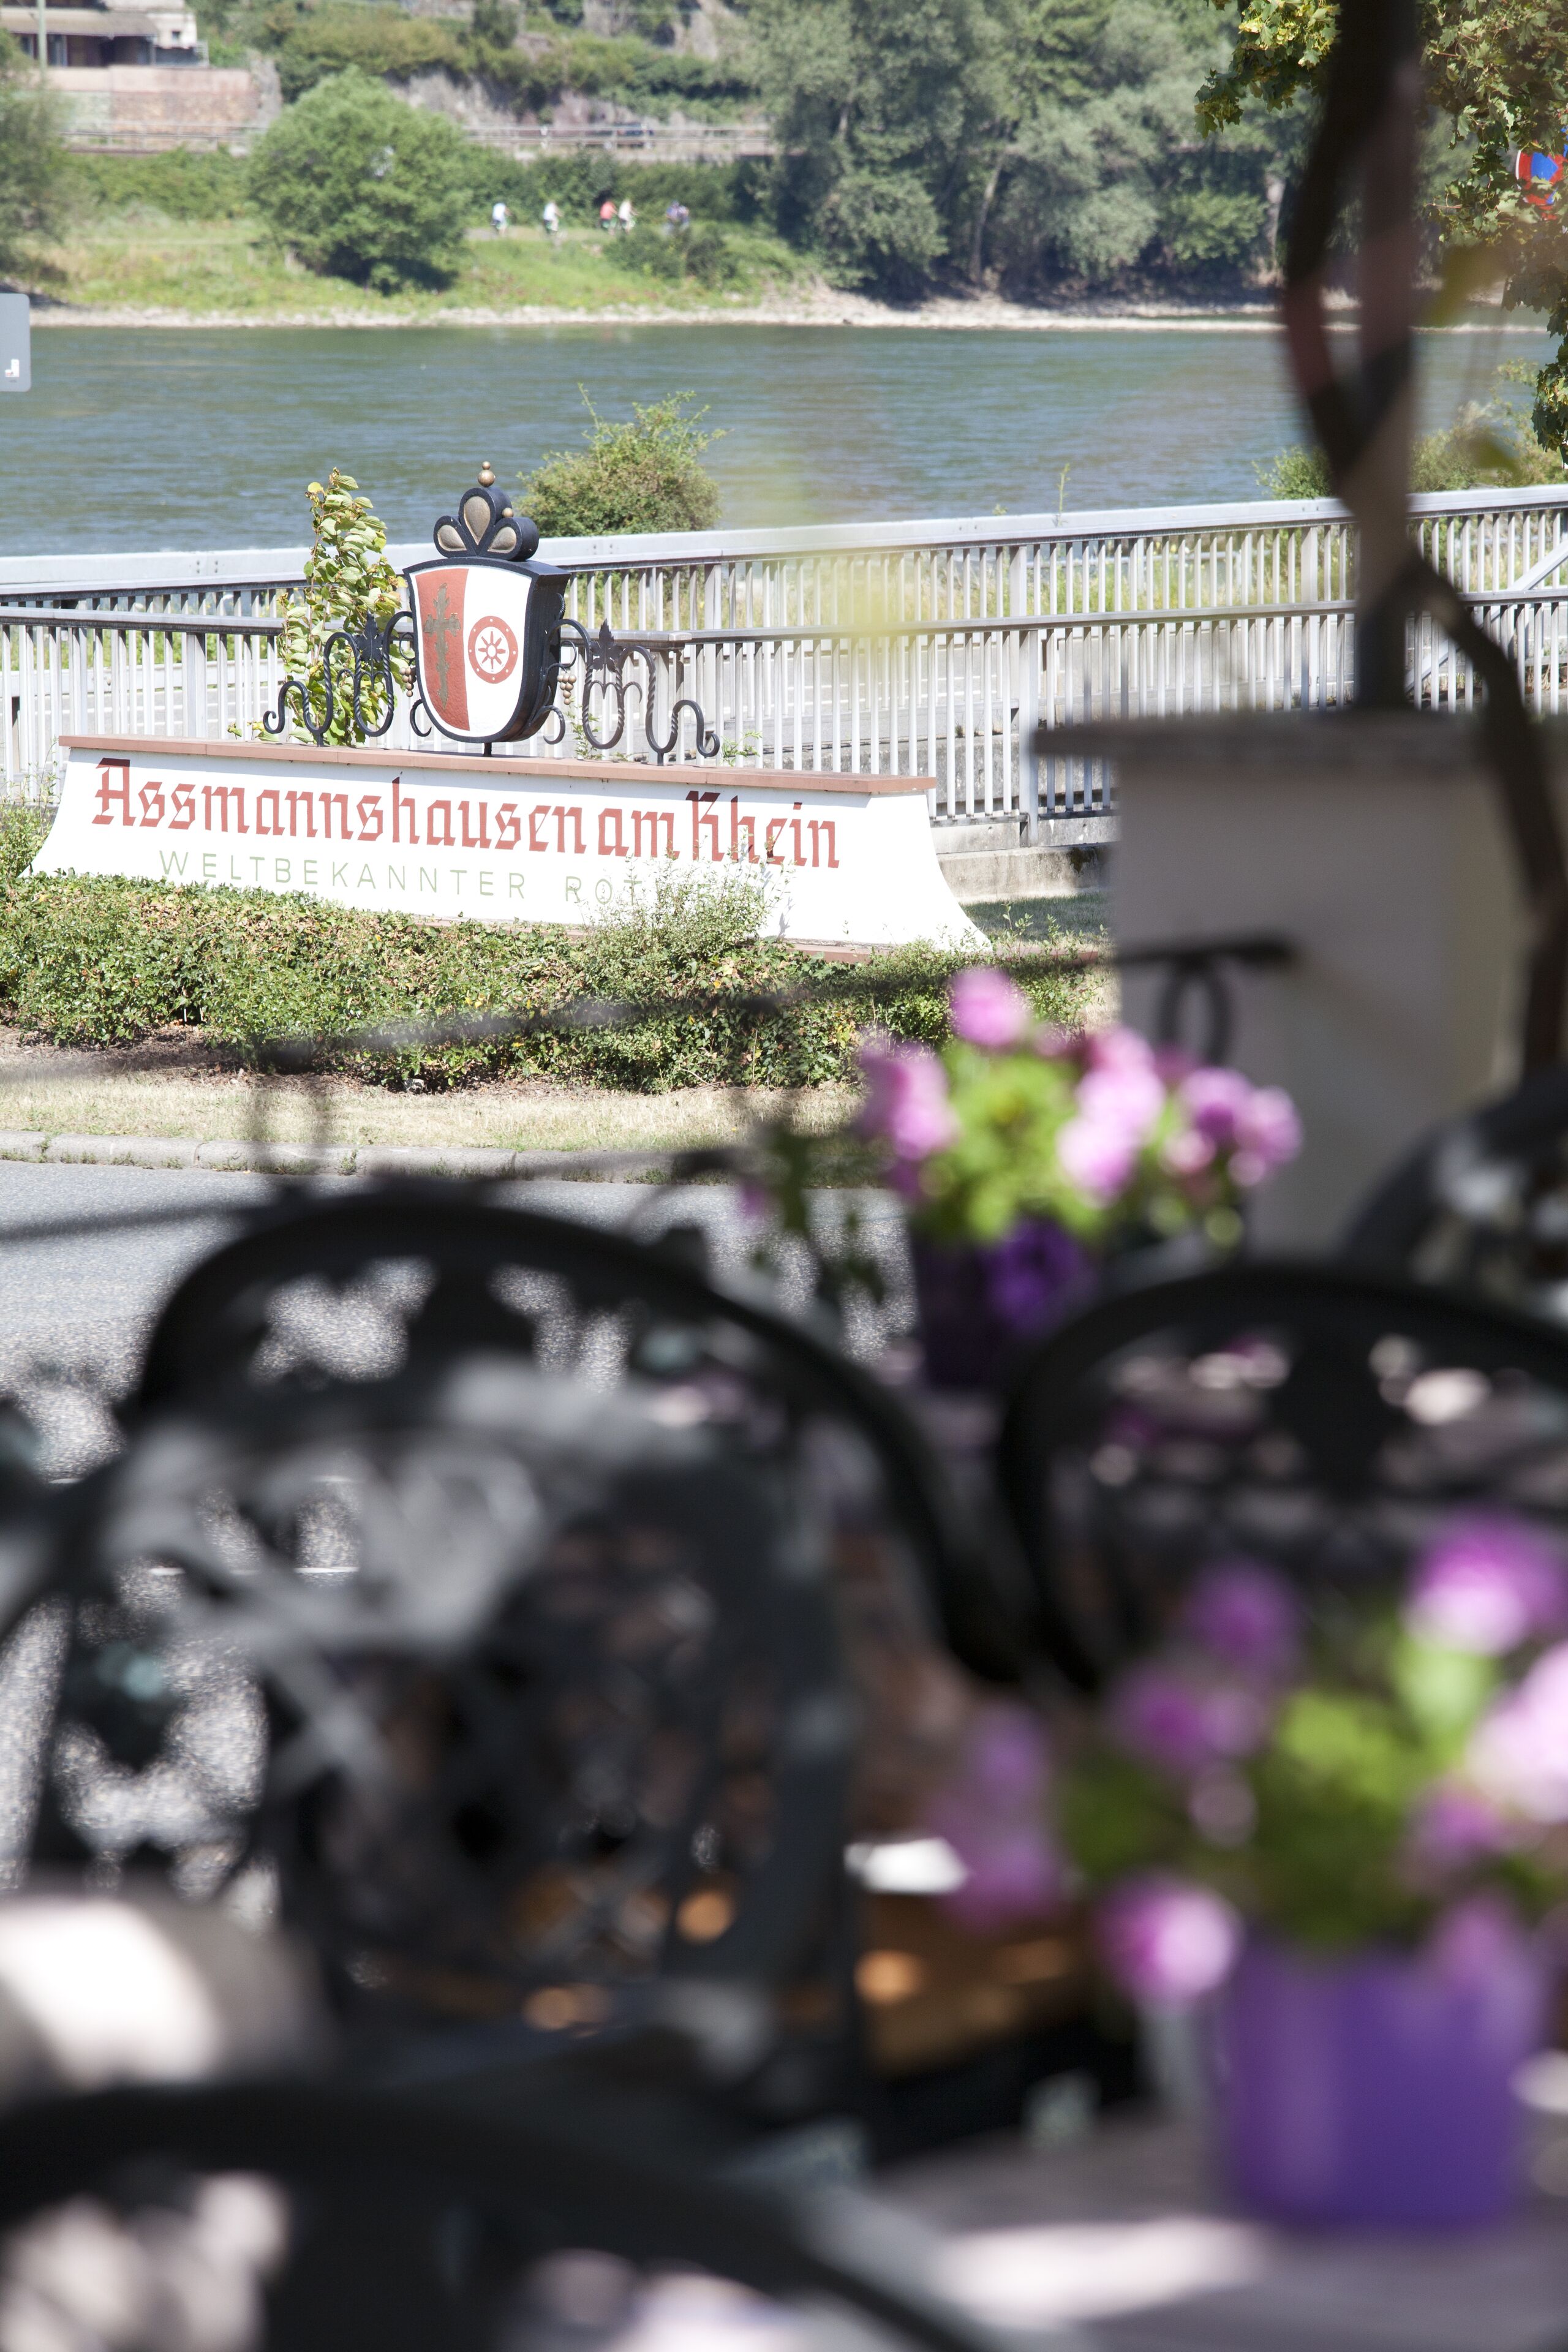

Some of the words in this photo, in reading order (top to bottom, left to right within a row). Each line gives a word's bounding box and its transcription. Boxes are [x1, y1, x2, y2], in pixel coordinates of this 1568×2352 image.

[92, 757, 586, 854] Assmannshausen
[598, 808, 680, 858] am
[685, 790, 840, 868] Rhein
[159, 850, 526, 899] WELTBEKANNTER
